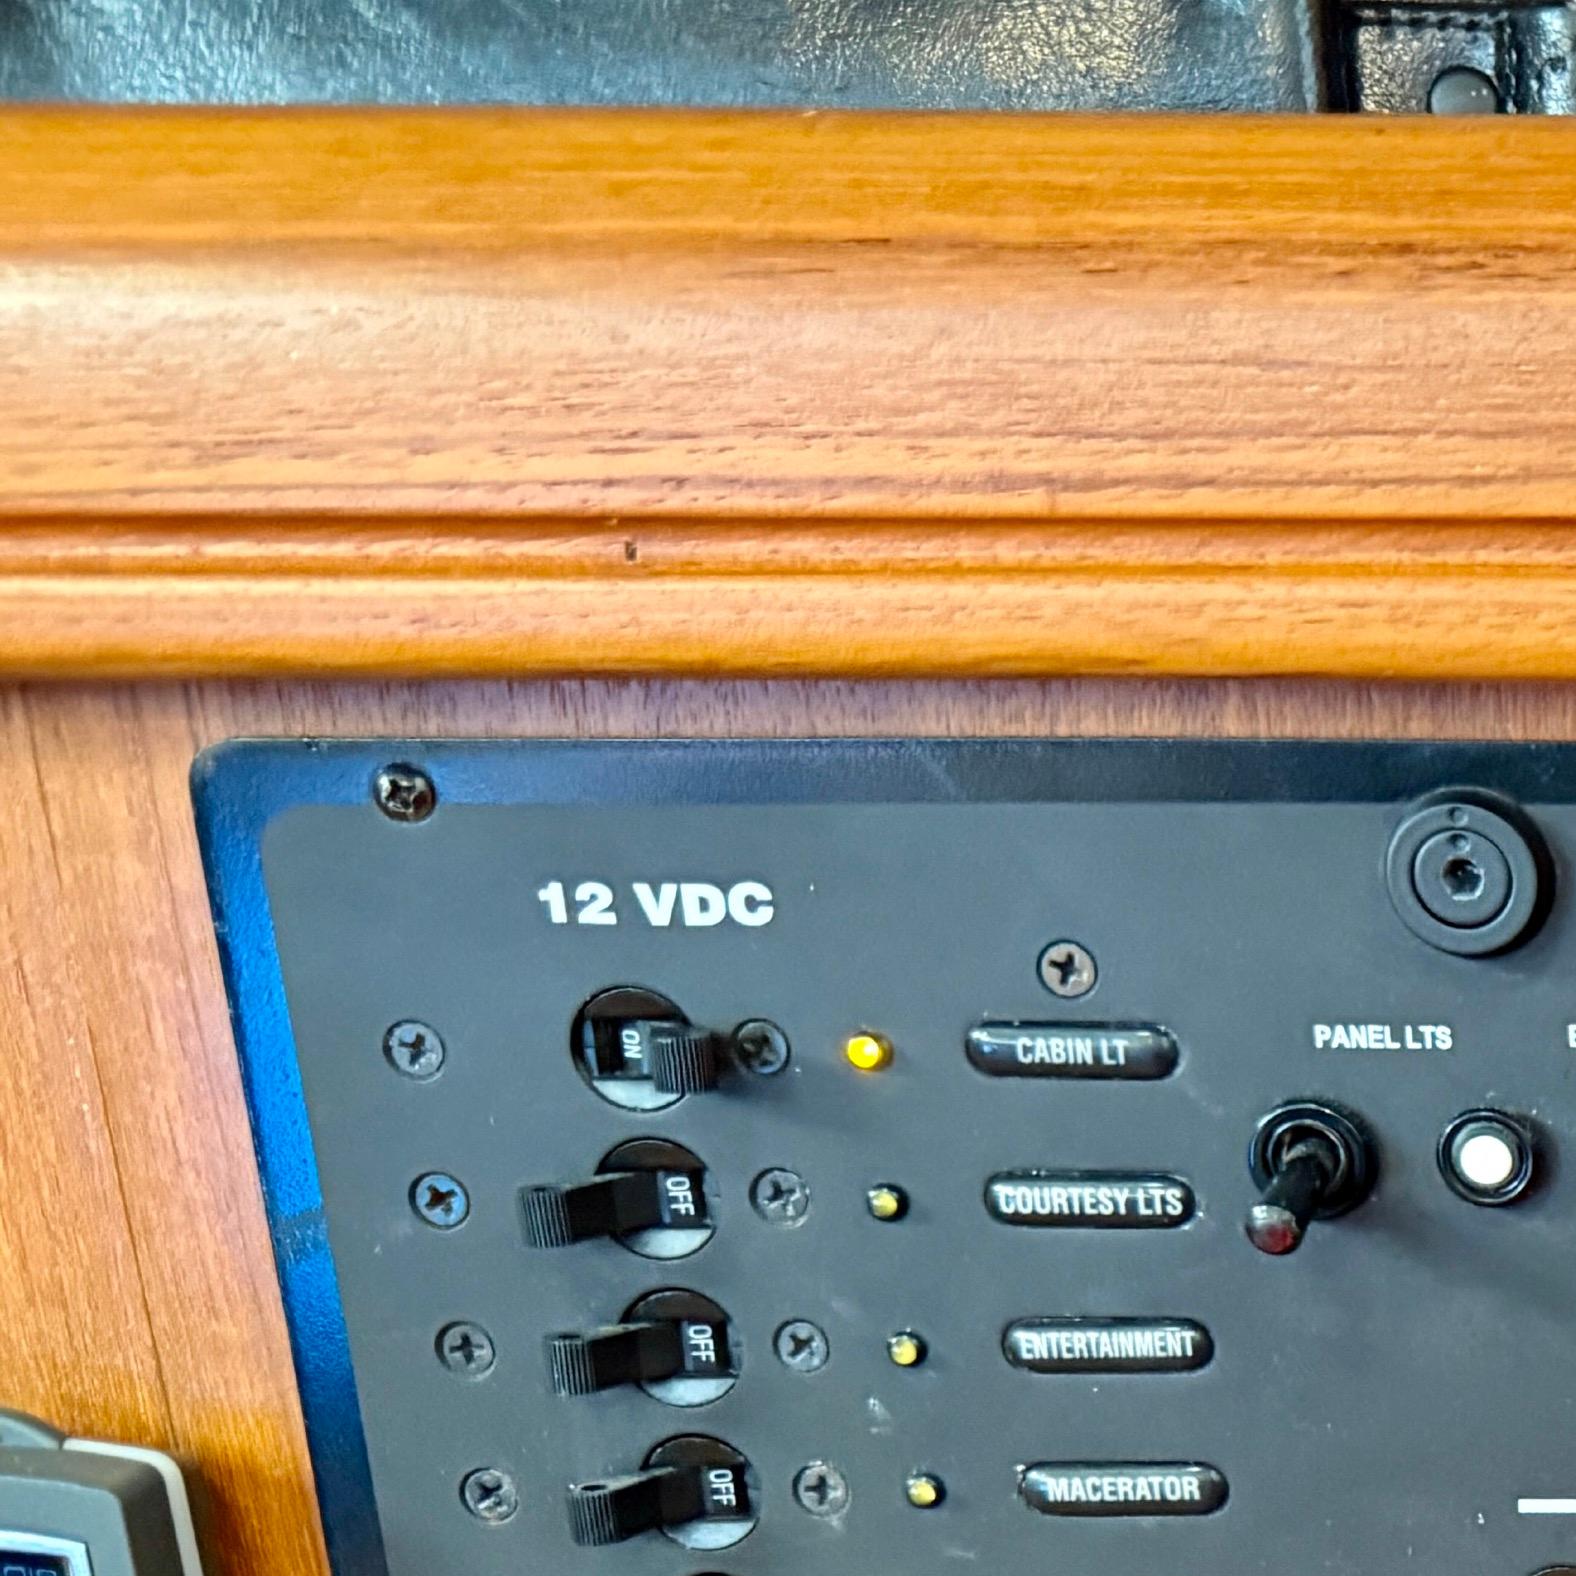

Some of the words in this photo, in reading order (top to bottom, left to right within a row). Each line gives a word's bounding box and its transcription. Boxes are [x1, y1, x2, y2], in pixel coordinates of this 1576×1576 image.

[539, 882, 617, 925] 12
[634, 882, 774, 927] VDC
[622, 1030, 642, 1058] ON
[1017, 1037, 1094, 1065] CABIN
[1100, 1039, 1127, 1066] LT
[1313, 1025, 1400, 1049] PANEL
[1404, 1025, 1453, 1050] LTS
[663, 1175, 694, 1217] OFF
[999, 1186, 1129, 1215] COURTESY
[1135, 1188, 1183, 1216] LTS
[687, 1324, 716, 1363] OFF
[1019, 1329, 1194, 1360] ENTERTAINMENT
[709, 1469, 737, 1506] OFF
[1046, 1474, 1199, 1502] MACERATOR
